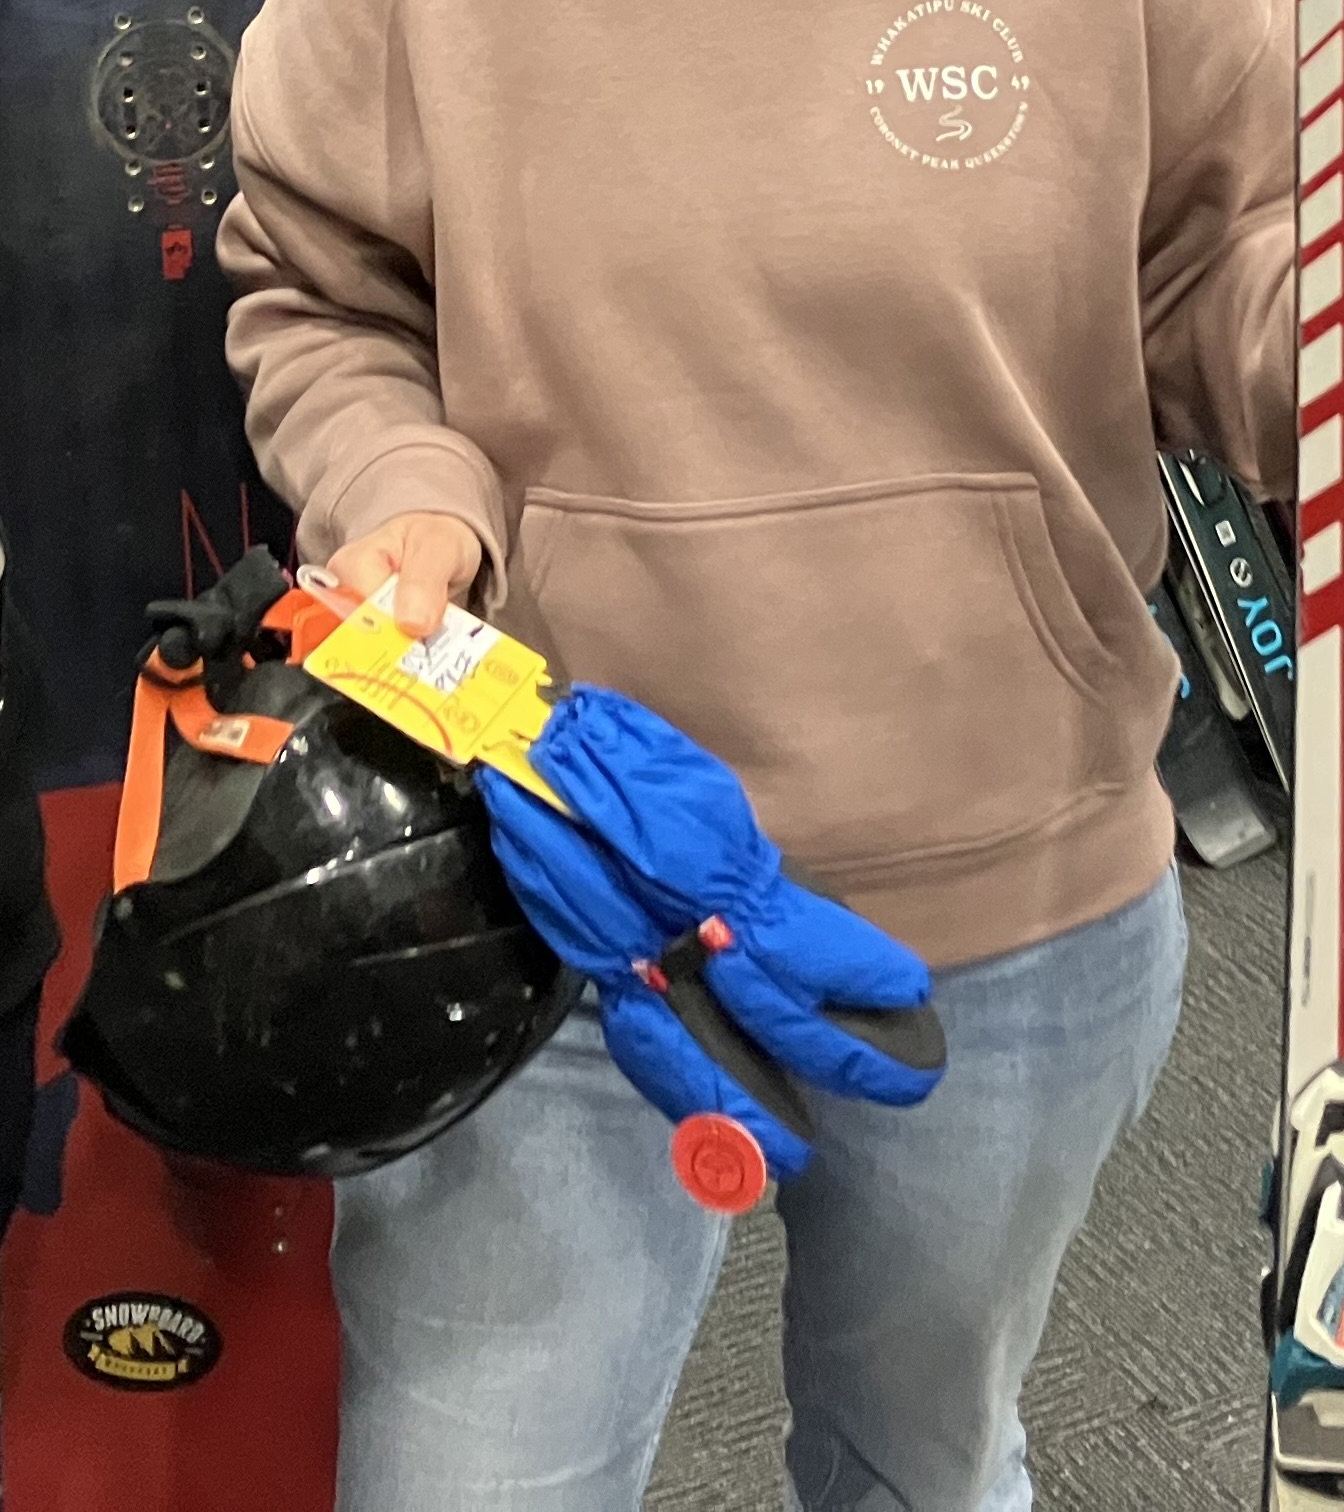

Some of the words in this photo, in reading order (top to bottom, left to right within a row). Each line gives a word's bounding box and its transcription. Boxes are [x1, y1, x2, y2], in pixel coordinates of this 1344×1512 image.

[959, 0, 992, 22] SKI
[992, 17, 1025, 64] CLUB
[895, 64, 1000, 103] WSC
[921, 153, 961, 170] PEAK
[1236, 597, 1294, 681] JOY
